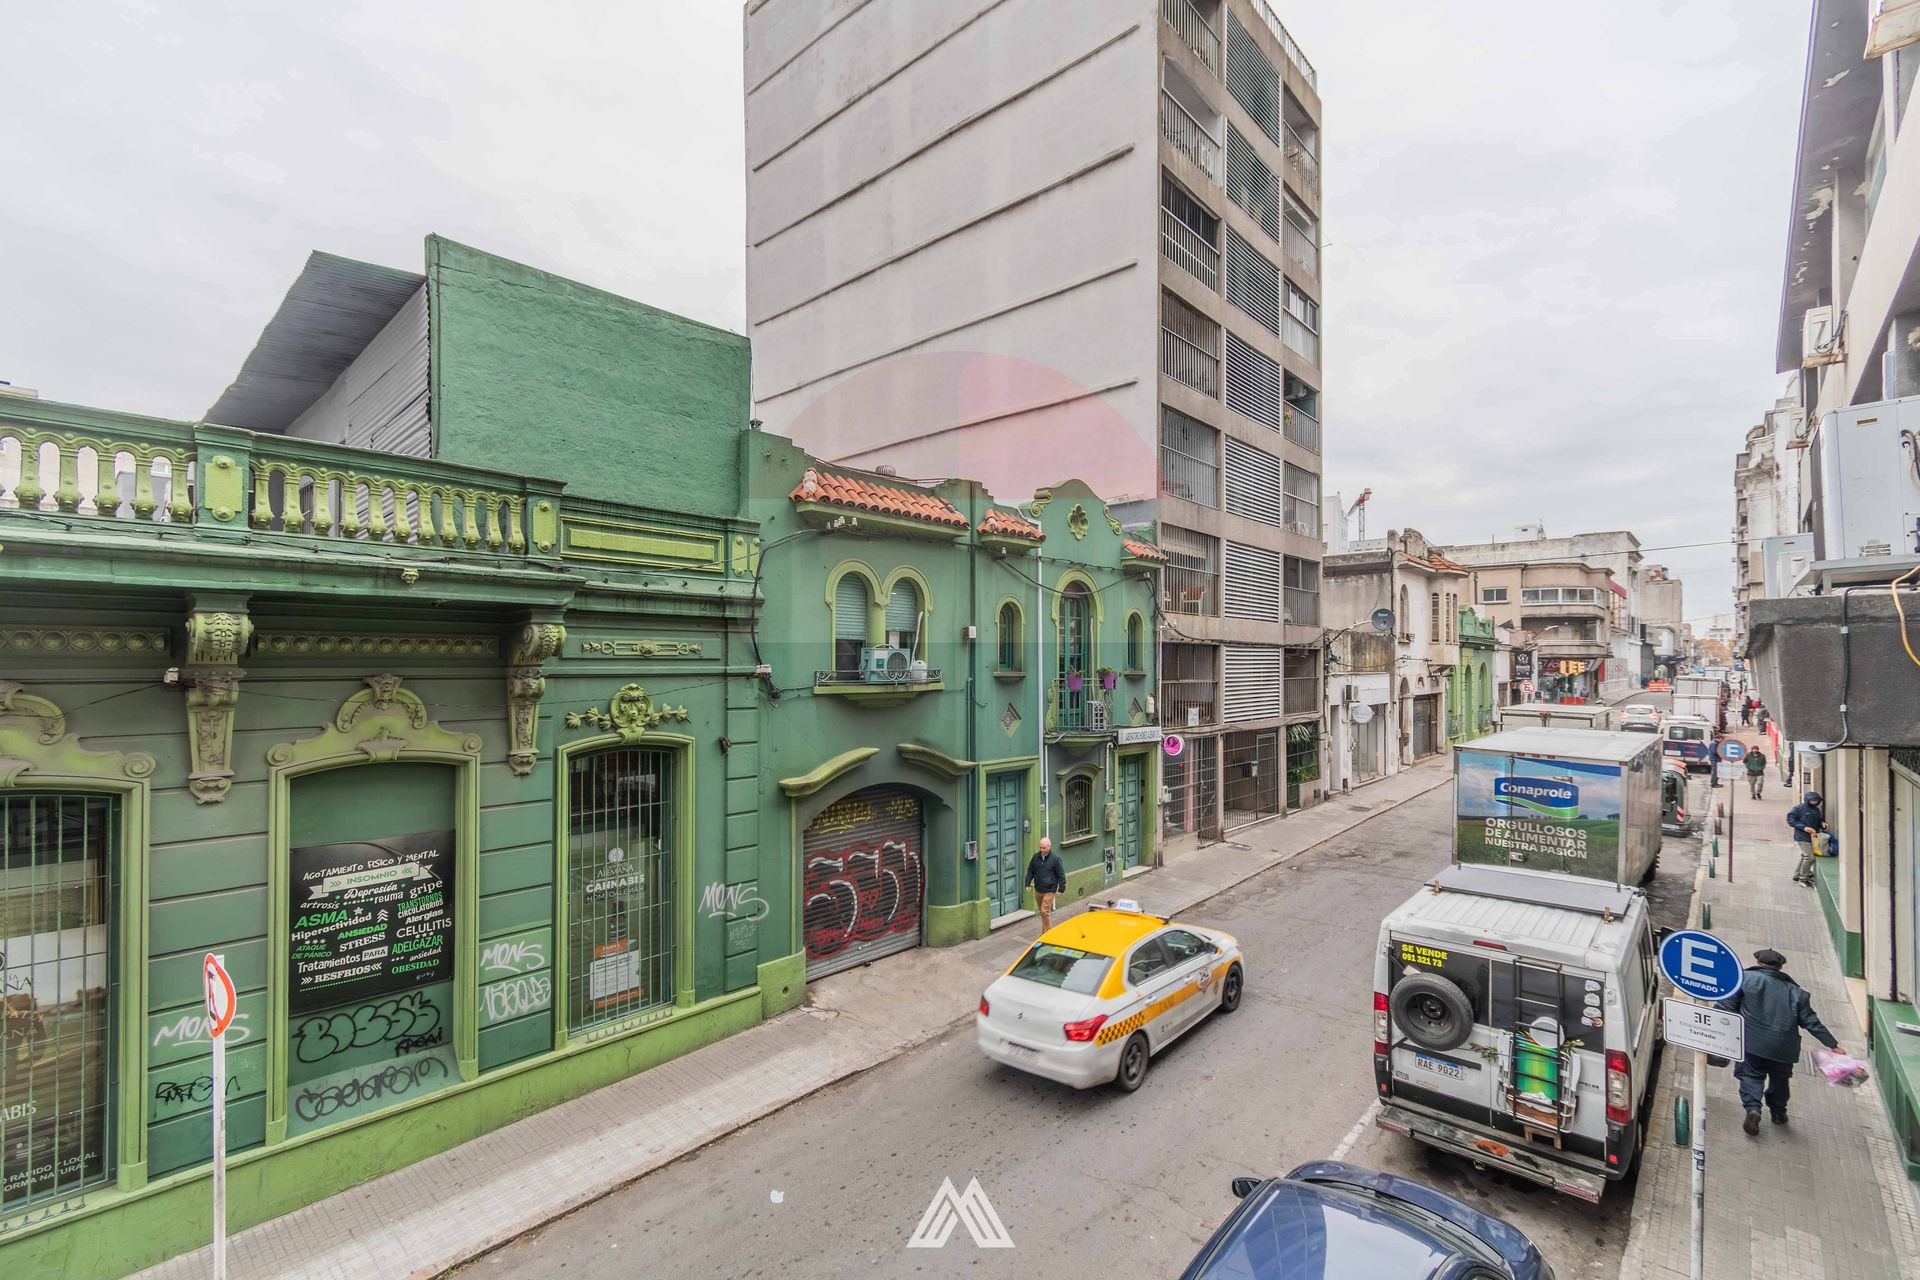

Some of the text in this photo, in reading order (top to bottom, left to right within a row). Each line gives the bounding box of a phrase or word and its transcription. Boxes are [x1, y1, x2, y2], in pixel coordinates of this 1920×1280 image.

[1726, 743, 1739, 758] E
[1500, 782, 1572, 799] Conaprole
[1485, 817, 1588, 839] ORGULLOSOS
[1485, 827, 1588, 850] DE ALIMENTAR
[1485, 836, 1588, 859] NUESTRA PASIÓN
[303, 864, 364, 880] AGOTAMIENTO
[405, 849, 440, 862] MENTAL
[346, 870, 397, 884] INSOMNIO
[586, 874, 645, 893] CANNABIS
[343, 882, 398, 899] Depresión
[374, 891, 404, 904] reuma
[409, 880, 443, 899] gripe
[300, 901, 340, 910] artrosis
[397, 899, 444, 919] CIRCULATORIOS
[291, 912, 372, 941] Hiperactividad
[294, 909, 348, 929] ASMA
[396, 917, 452, 938] CELULITIS
[337, 923, 388, 940] ANSIEDAD
[296, 944, 327, 952] ATAQUE
[339, 931, 386, 952] STRESS
[391, 935, 443, 955] ADELGAZAR
[297, 949, 386, 974] Tratamientos PARA
[304, 950, 332, 959] PÁNICO
[409, 946, 442, 961] ansiedad
[1401, 944, 1448, 960] SE VENDE
[1402, 953, 1416, 962] 091
[1417, 956, 1432, 965] 321
[1681, 937, 1718, 985] E
[313, 964, 371, 983] RESFRIOS
[391, 959, 440, 975] OBESIDAD
[1680, 977, 1718, 993] TARIFADO
[1689, 1028, 1717, 1040] Tarifado
[1417, 1058, 1460, 1078] RAE 9022
[64, 1152, 98, 1166] LOCAL
[3, 1177, 37, 1192] ORMA
[40, 1164, 89, 1181] NAURAL
